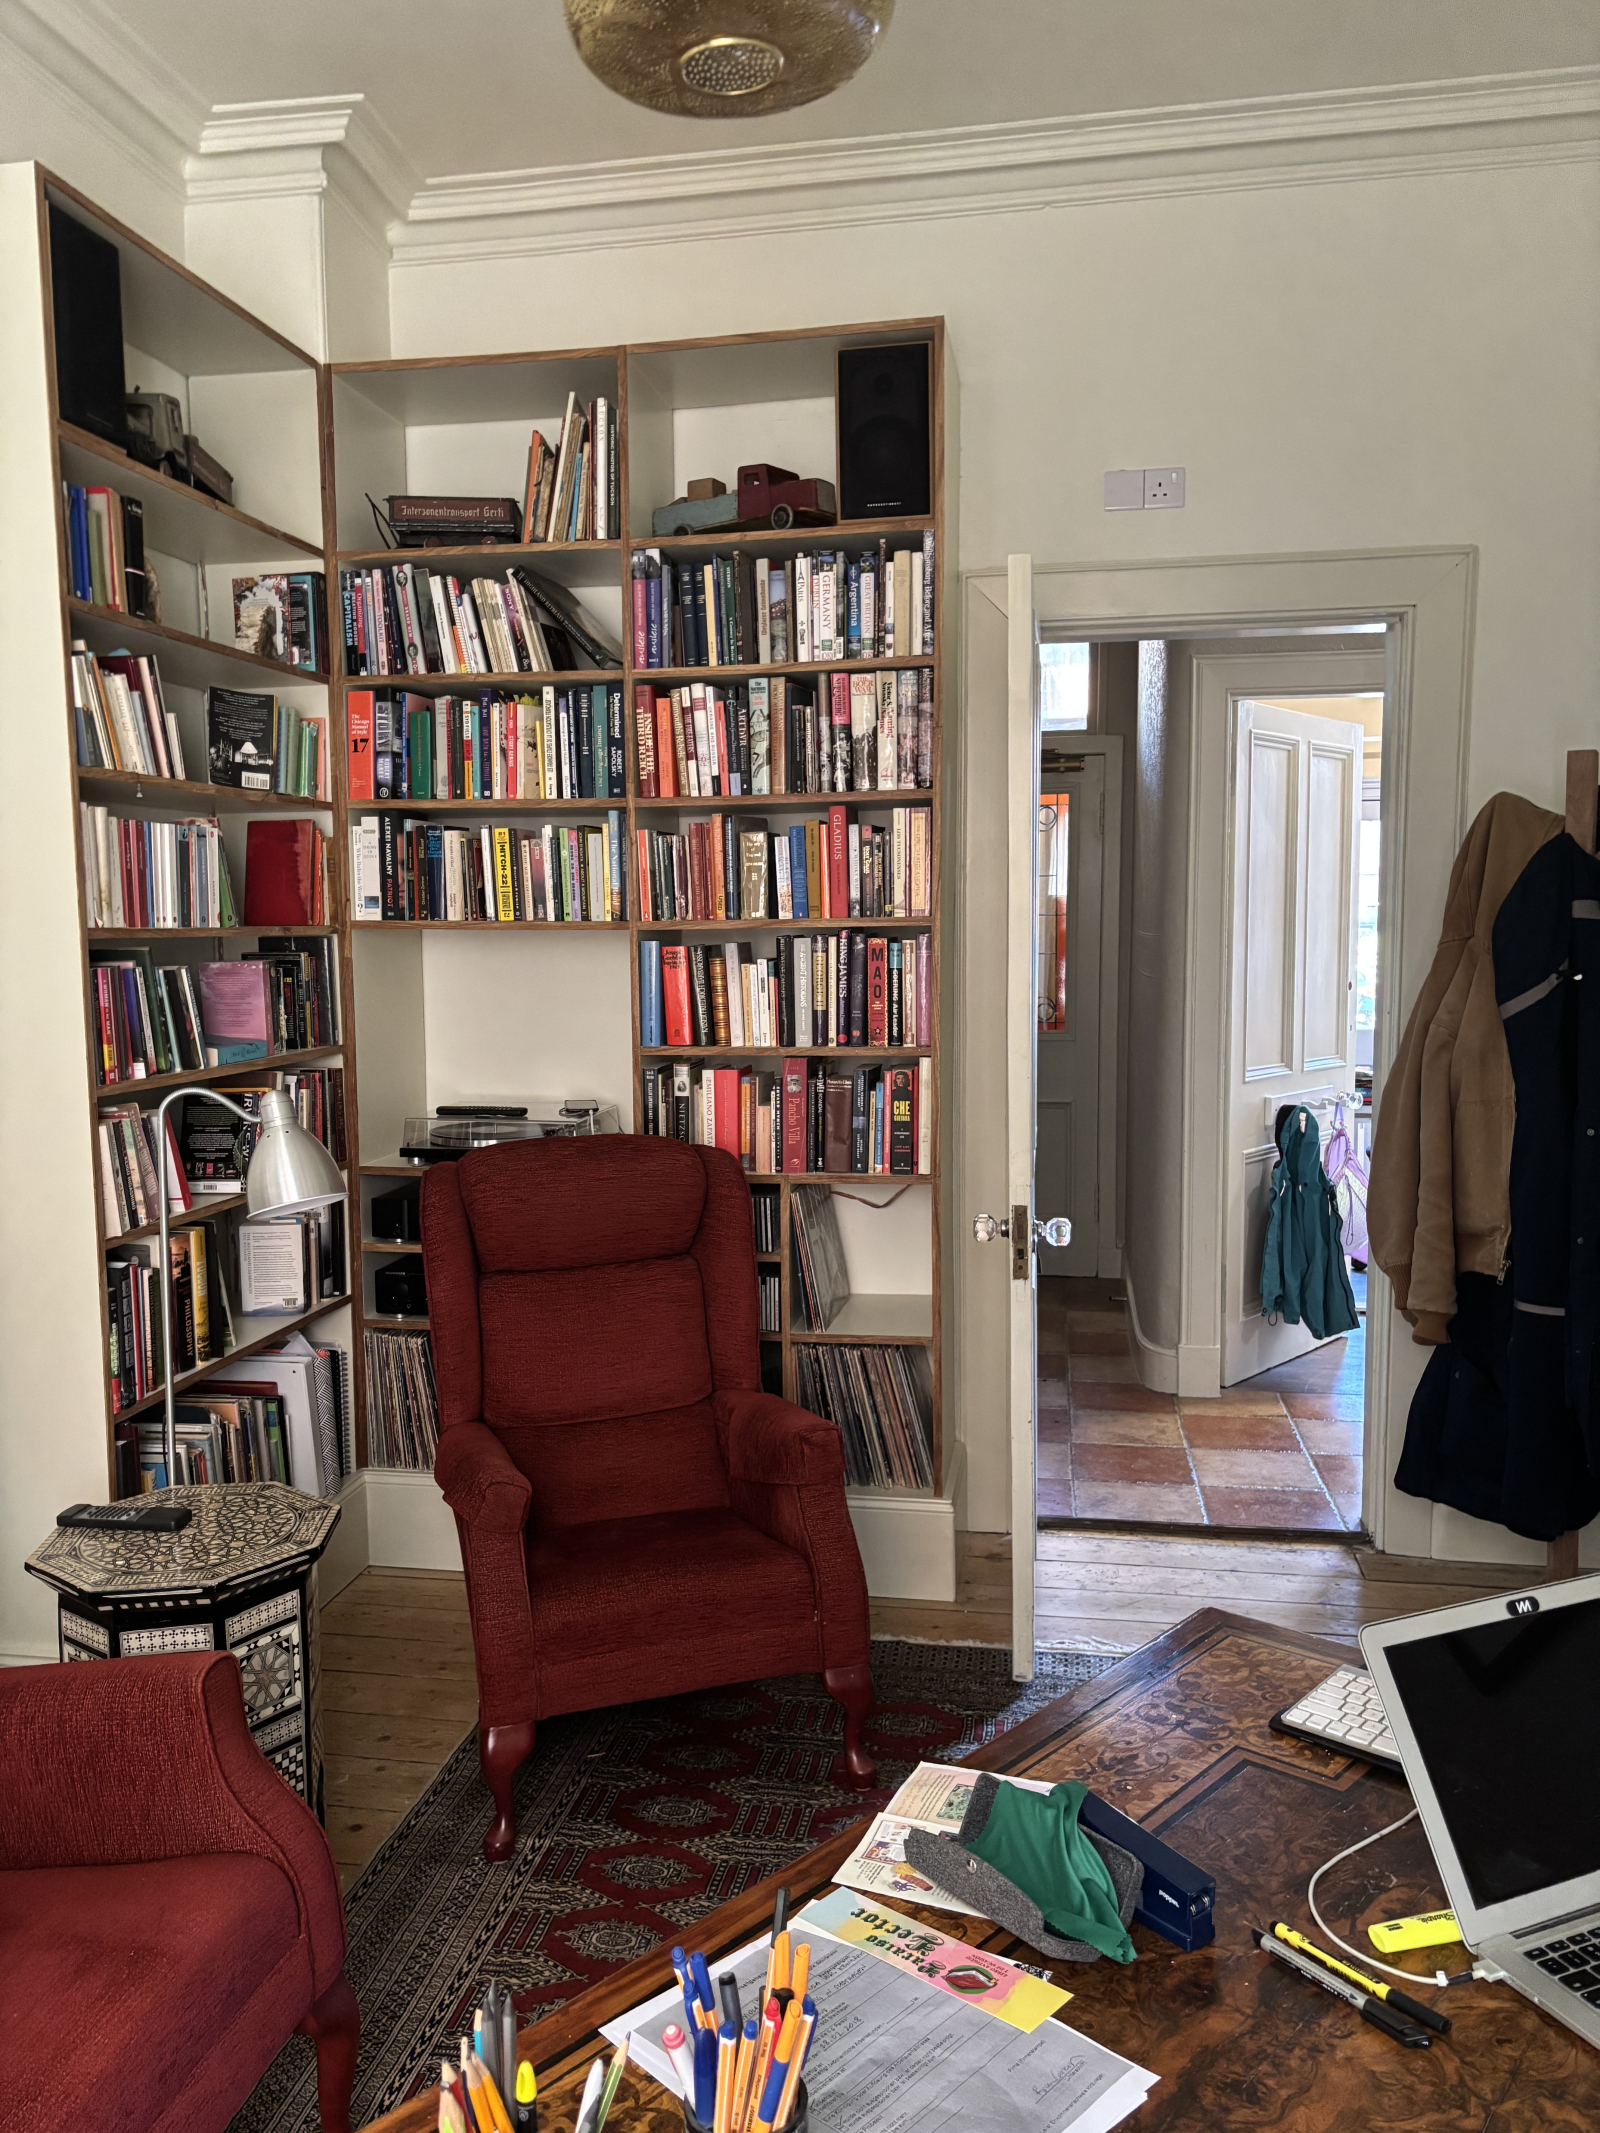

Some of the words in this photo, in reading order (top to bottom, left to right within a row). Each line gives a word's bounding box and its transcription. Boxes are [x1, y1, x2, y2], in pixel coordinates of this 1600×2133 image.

[505, 588, 514, 610] SONY
[523, 579, 544, 602] HIGHLAND
[822, 575, 830, 629] GERMANY
[849, 581, 858, 626] Argentina
[923, 586, 932, 608] Before
[344, 594, 353, 646] CAPITALISM
[924, 609, 932, 621] and
[377, 705, 389, 748] STORY
[636, 707, 645, 745] THIRD
[672, 693, 683, 734] Monmouth's
[886, 709, 894, 739] Naming
[644, 713, 653, 747] INSIDE
[773, 736, 778, 744] TO
[352, 738, 369, 753] 17
[646, 748, 654, 773] THE
[676, 736, 685, 758] Rebels
[639, 746, 647, 780] REICH
[833, 814, 841, 860] GLADIUS
[500, 845, 508, 886] HITCH-22
[611, 855, 619, 884] National
[864, 859, 872, 874] GRAIL
[612, 887, 620, 905] Road
[839, 939, 847, 963] KING
[839, 964, 847, 997] JAMES
[871, 948, 883, 998] MAO
[788, 1098, 800, 1126] Pancho
[894, 1101, 910, 1114] CHE
[788, 1127, 801, 1144] Villa
[127, 1176, 136, 1210] HIGASHINO
[196, 1260, 207, 1297] TUCSON
[184, 1299, 193, 1356] PHILOSOPHY
[851, 1908, 945, 1956] Lector
[1421, 1912, 1455, 1924] Sharpie
